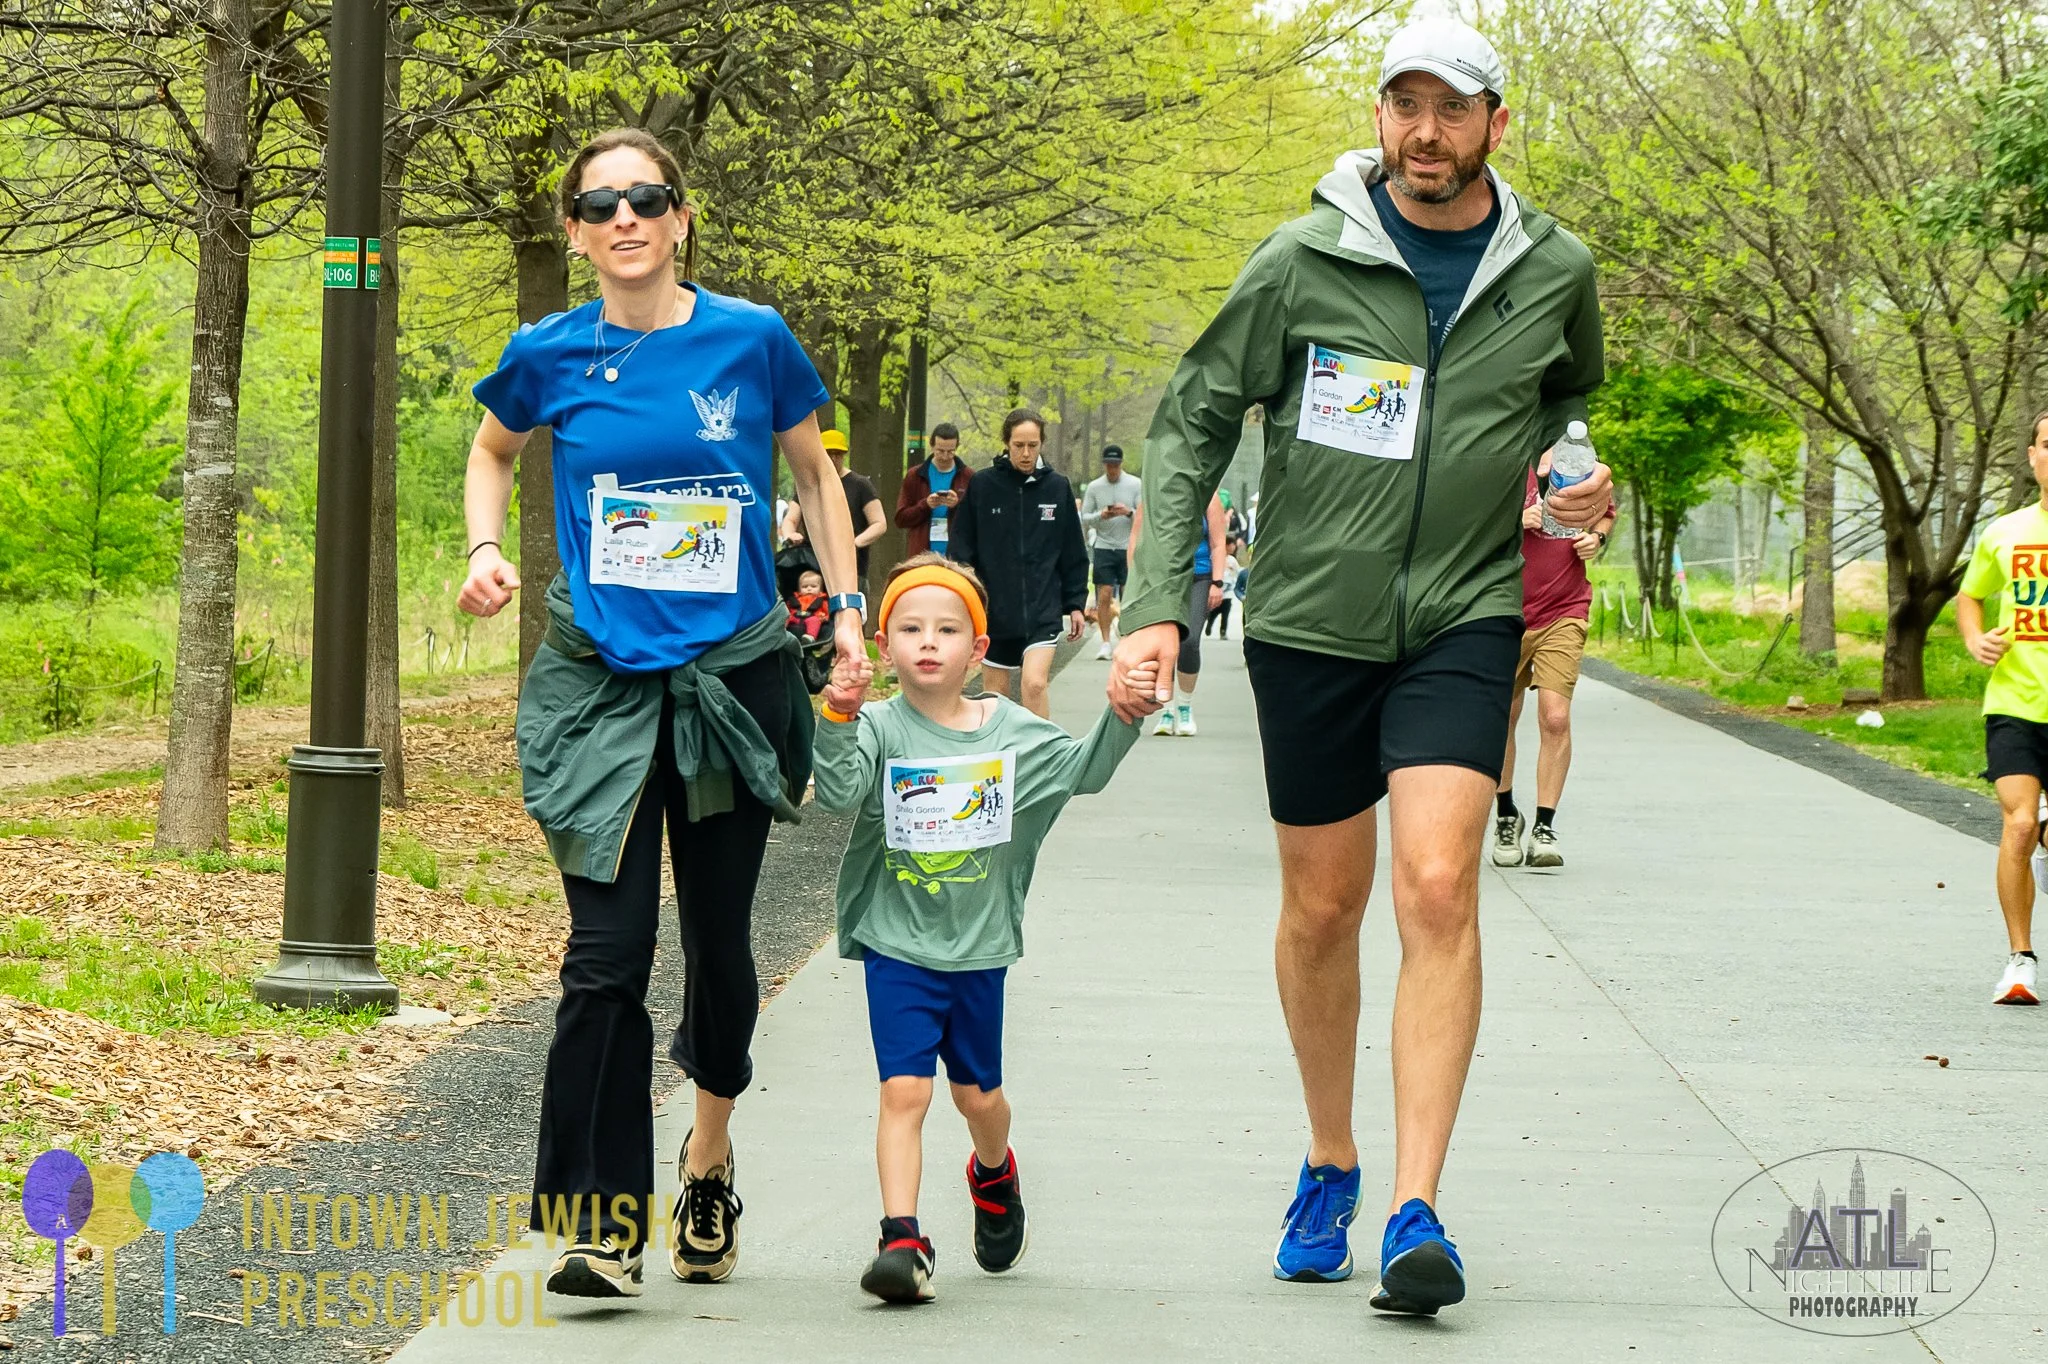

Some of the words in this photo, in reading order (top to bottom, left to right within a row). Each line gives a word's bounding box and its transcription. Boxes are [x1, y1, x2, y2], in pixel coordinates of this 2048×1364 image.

[1323, 358, 1345, 373] RUN
[1318, 388, 1343, 401] Gordon
[602, 510, 626, 525] FUN
[631, 508, 659, 521] RUN
[625, 538, 649, 548] Rubin
[892, 778, 913, 794] FUN
[918, 774, 945, 786] RUN
[896, 804, 914, 814] Shilo
[915, 806, 945, 814] Gordon
